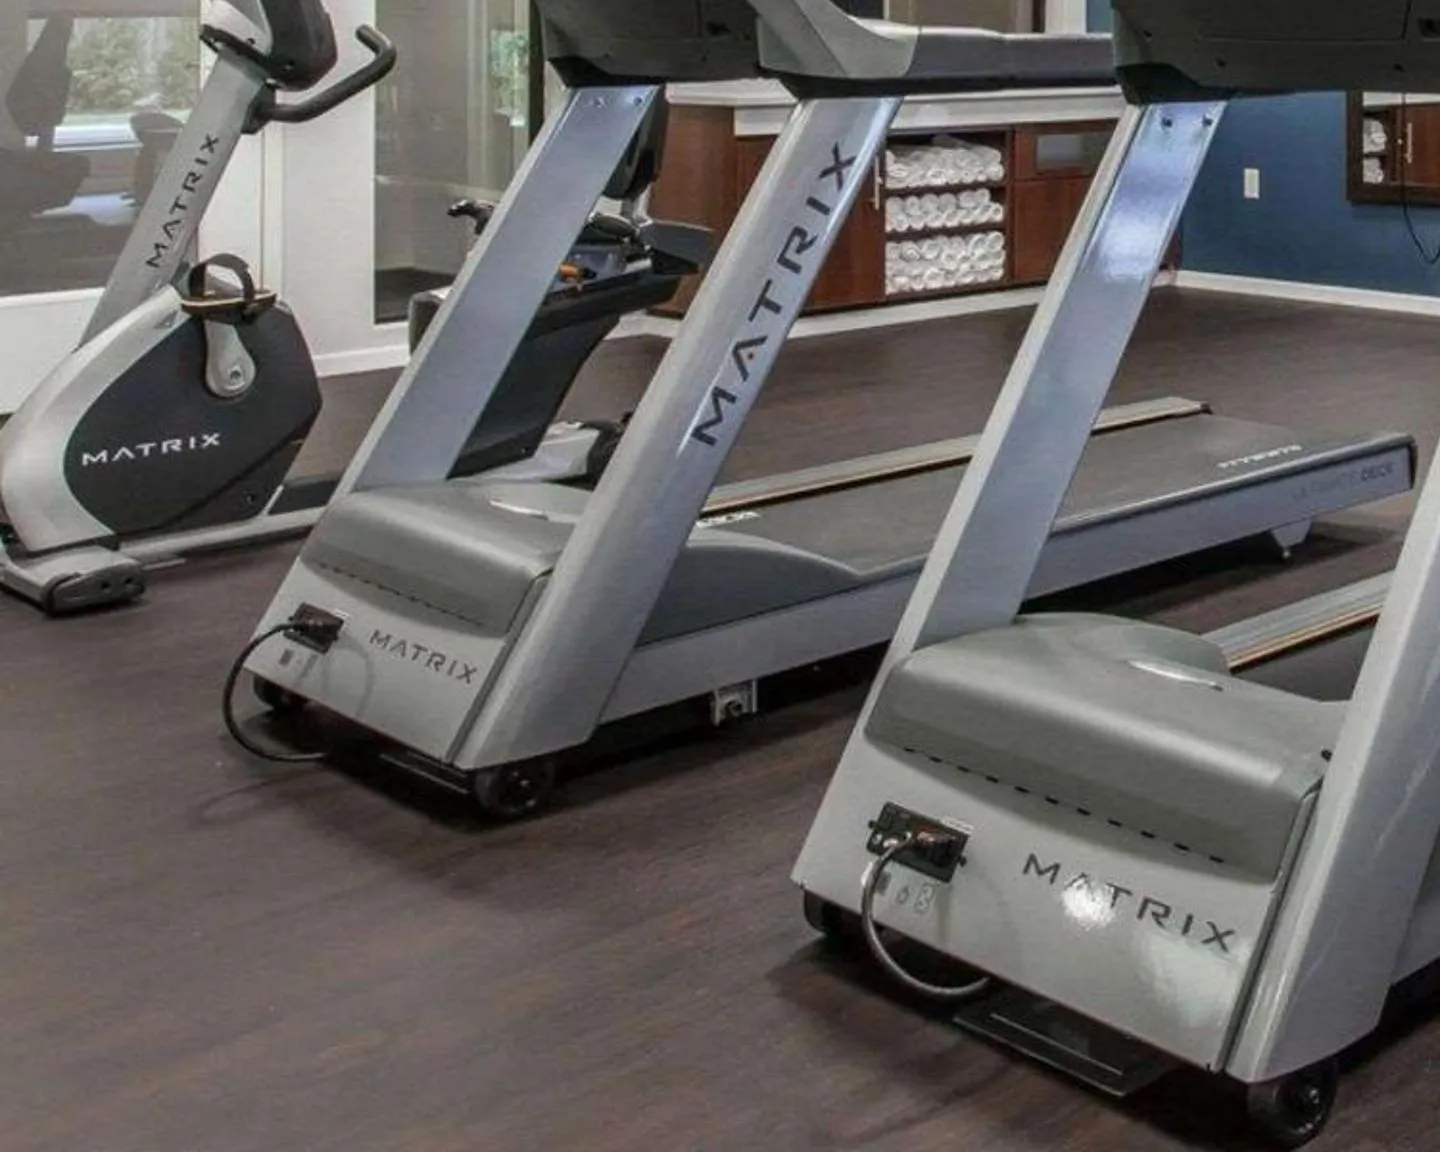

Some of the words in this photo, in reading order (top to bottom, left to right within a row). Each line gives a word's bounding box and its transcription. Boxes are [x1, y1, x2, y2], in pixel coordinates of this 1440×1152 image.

[146, 134, 219, 268] MATRIX
[691, 141, 858, 447] MATRIX
[81, 432, 221, 467] MATRIX
[368, 628, 478, 685] MATRIX
[1021, 852, 1236, 953] MATRIX
